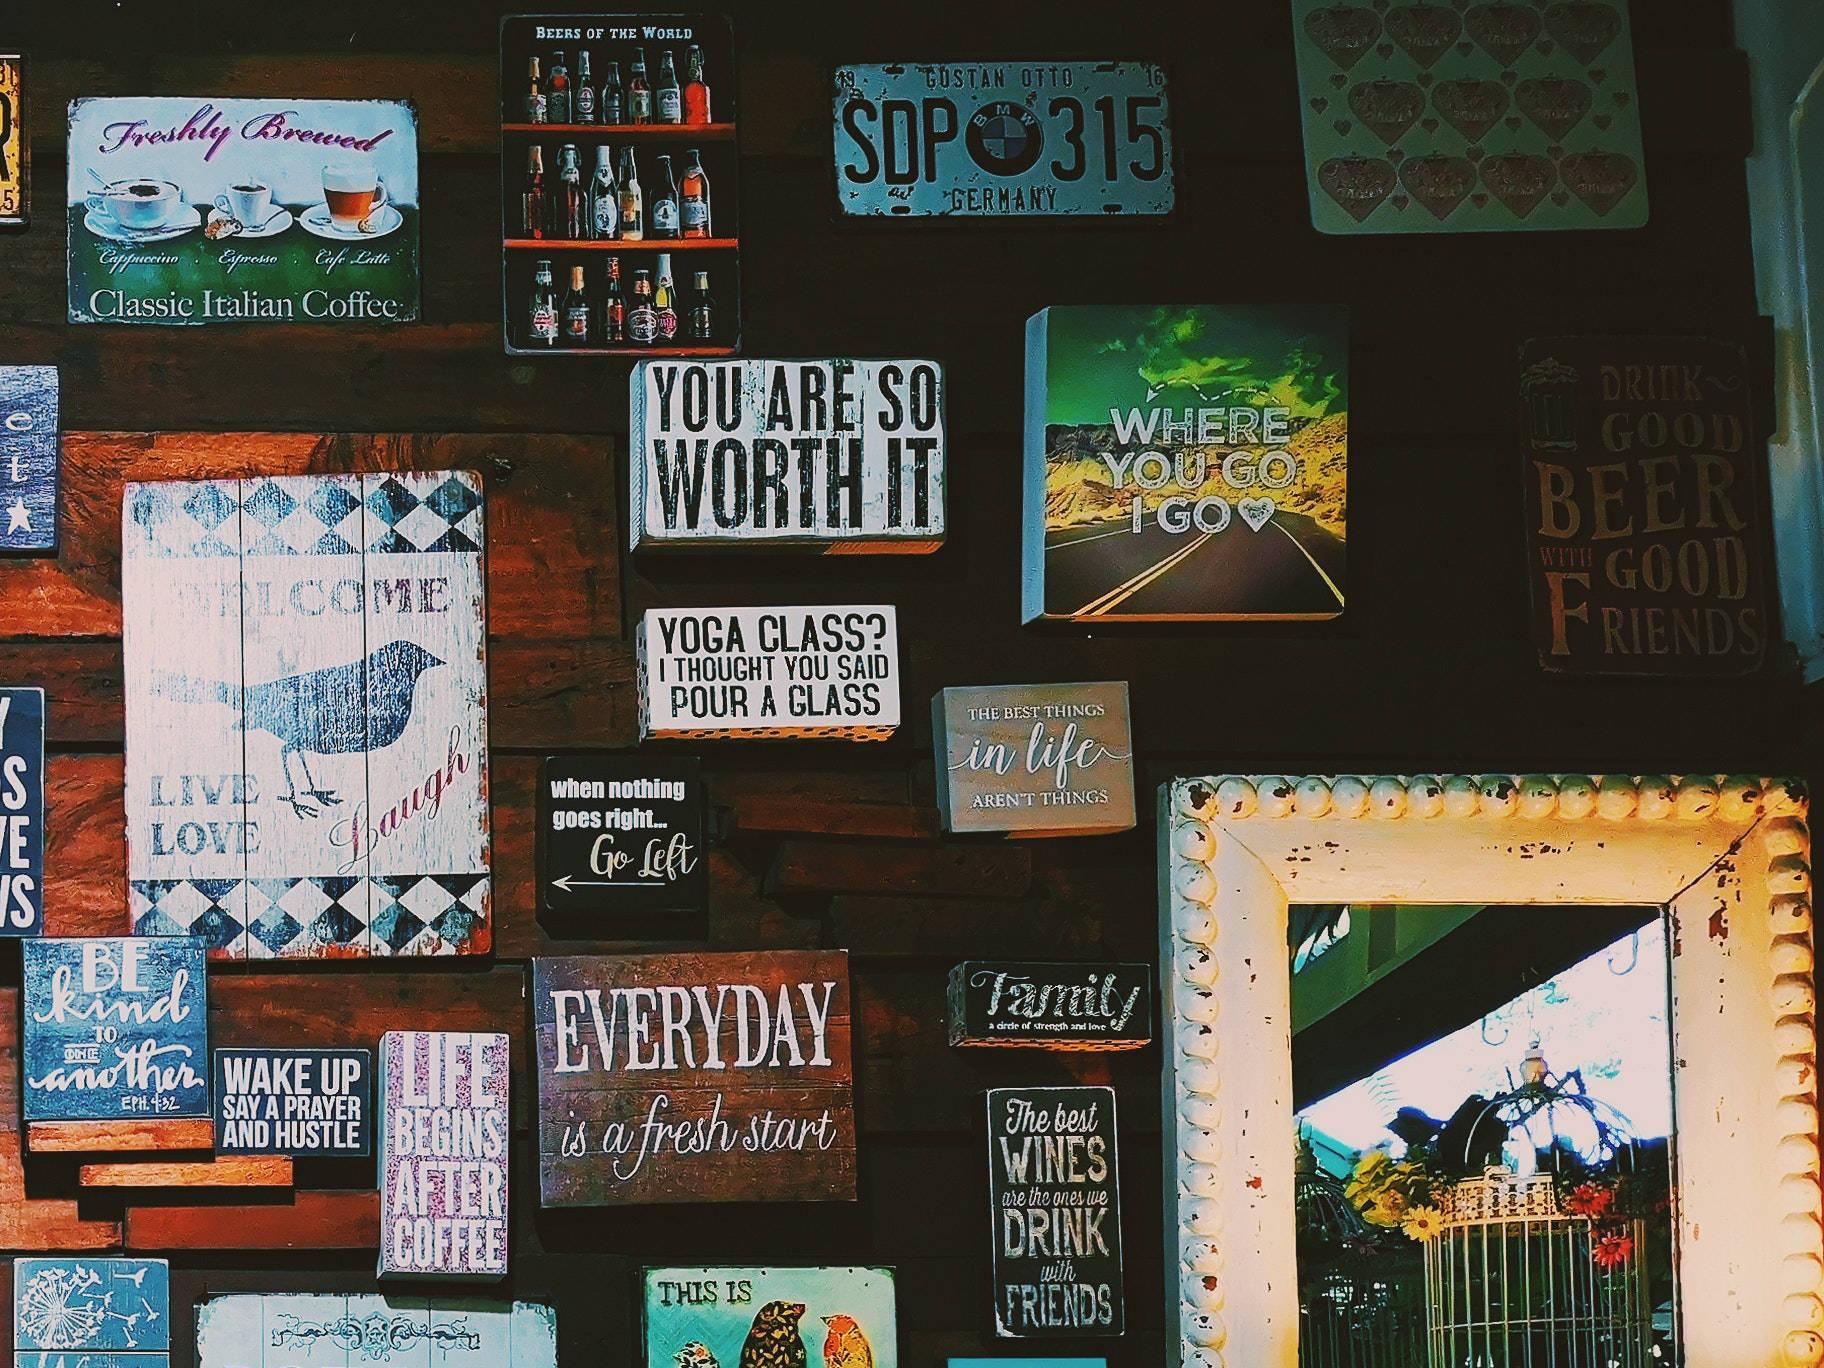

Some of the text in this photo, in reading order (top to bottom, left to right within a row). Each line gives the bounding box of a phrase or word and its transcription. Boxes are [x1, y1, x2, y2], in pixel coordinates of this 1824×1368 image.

[100, 105, 394, 161] Freshly Brewed
[844, 99, 1164, 184] SDP 315
[98, 249, 277, 269] Cappuccino Espresso
[90, 289, 397, 319] Classic Italian Coffee
[652, 365, 936, 432] YOU ARE SO
[1111, 408, 1290, 444] WHERE
[654, 438, 937, 529] WORTH IT
[1102, 452, 1296, 489] YOU GO
[1132, 498, 1231, 532] I GO
[1532, 451, 1746, 539] BEER
[1604, 539, 1748, 600] GOOD
[658, 615, 887, 655] YOGA CLASS?
[671, 685, 879, 718] POUR A GLASS
[968, 704, 1105, 720] THE BEST THINGS
[972, 790, 1108, 807] AREN'T THINGS
[551, 982, 835, 1073] EVERYDAY
[224, 1058, 360, 1095] WAKE UP
[1001, 1137, 1107, 1184] WINES
[1003, 1209, 1110, 1258] DRINK
[1006, 1284, 1112, 1327] FRIENDS
